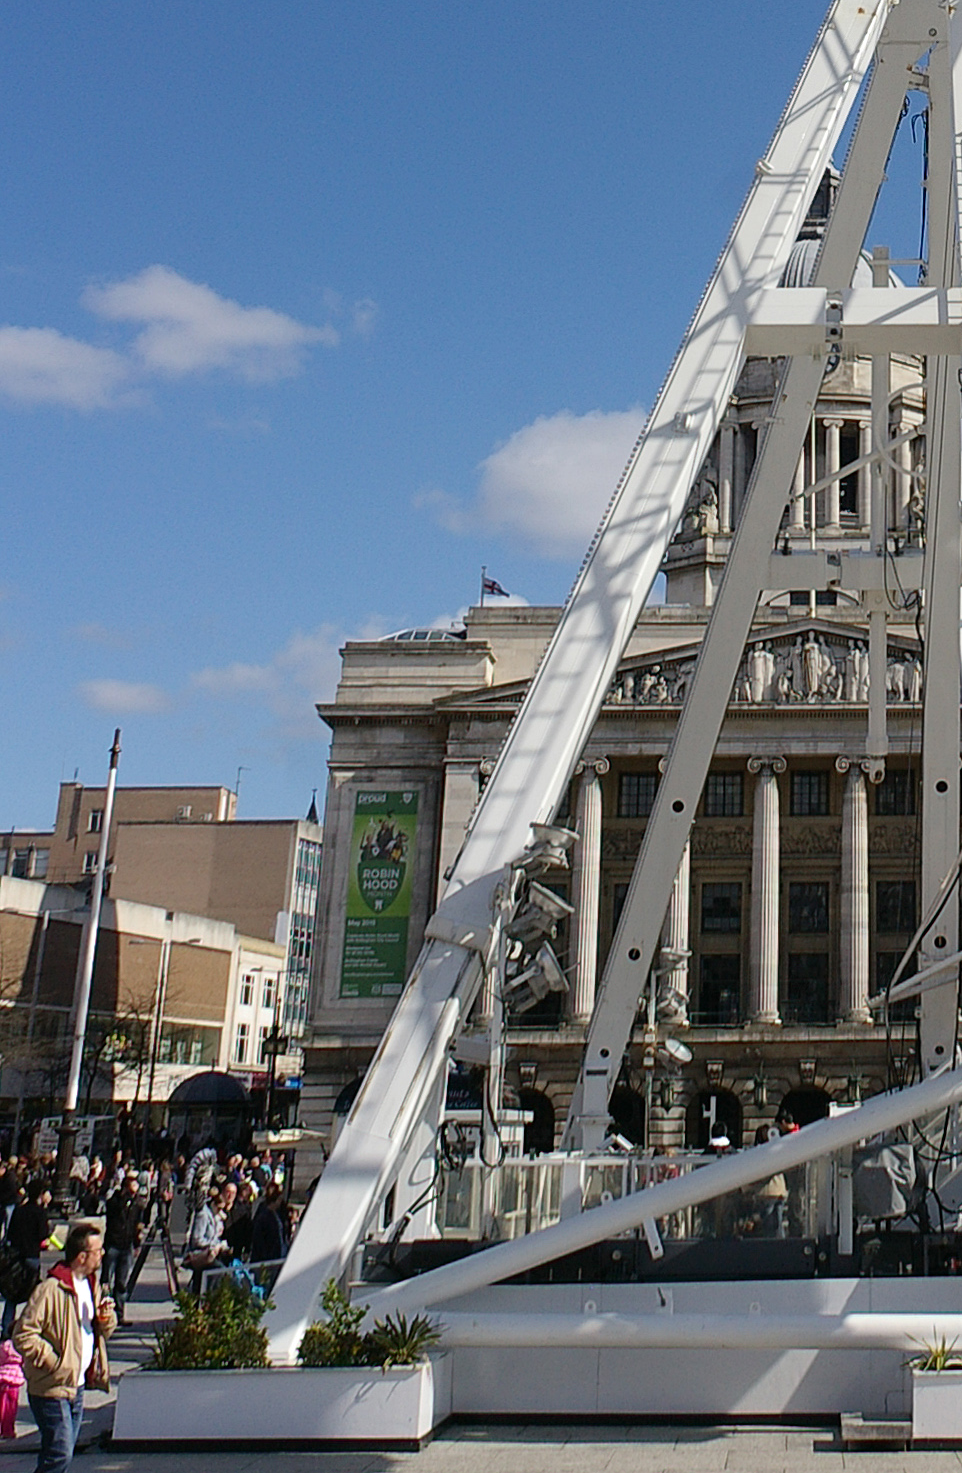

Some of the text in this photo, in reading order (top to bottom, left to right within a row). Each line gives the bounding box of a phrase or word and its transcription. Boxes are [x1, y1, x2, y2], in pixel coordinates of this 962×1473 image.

[358, 793, 387, 805] proud
[363, 868, 400, 879] ROBIN
[363, 879, 399, 890] HOOD
